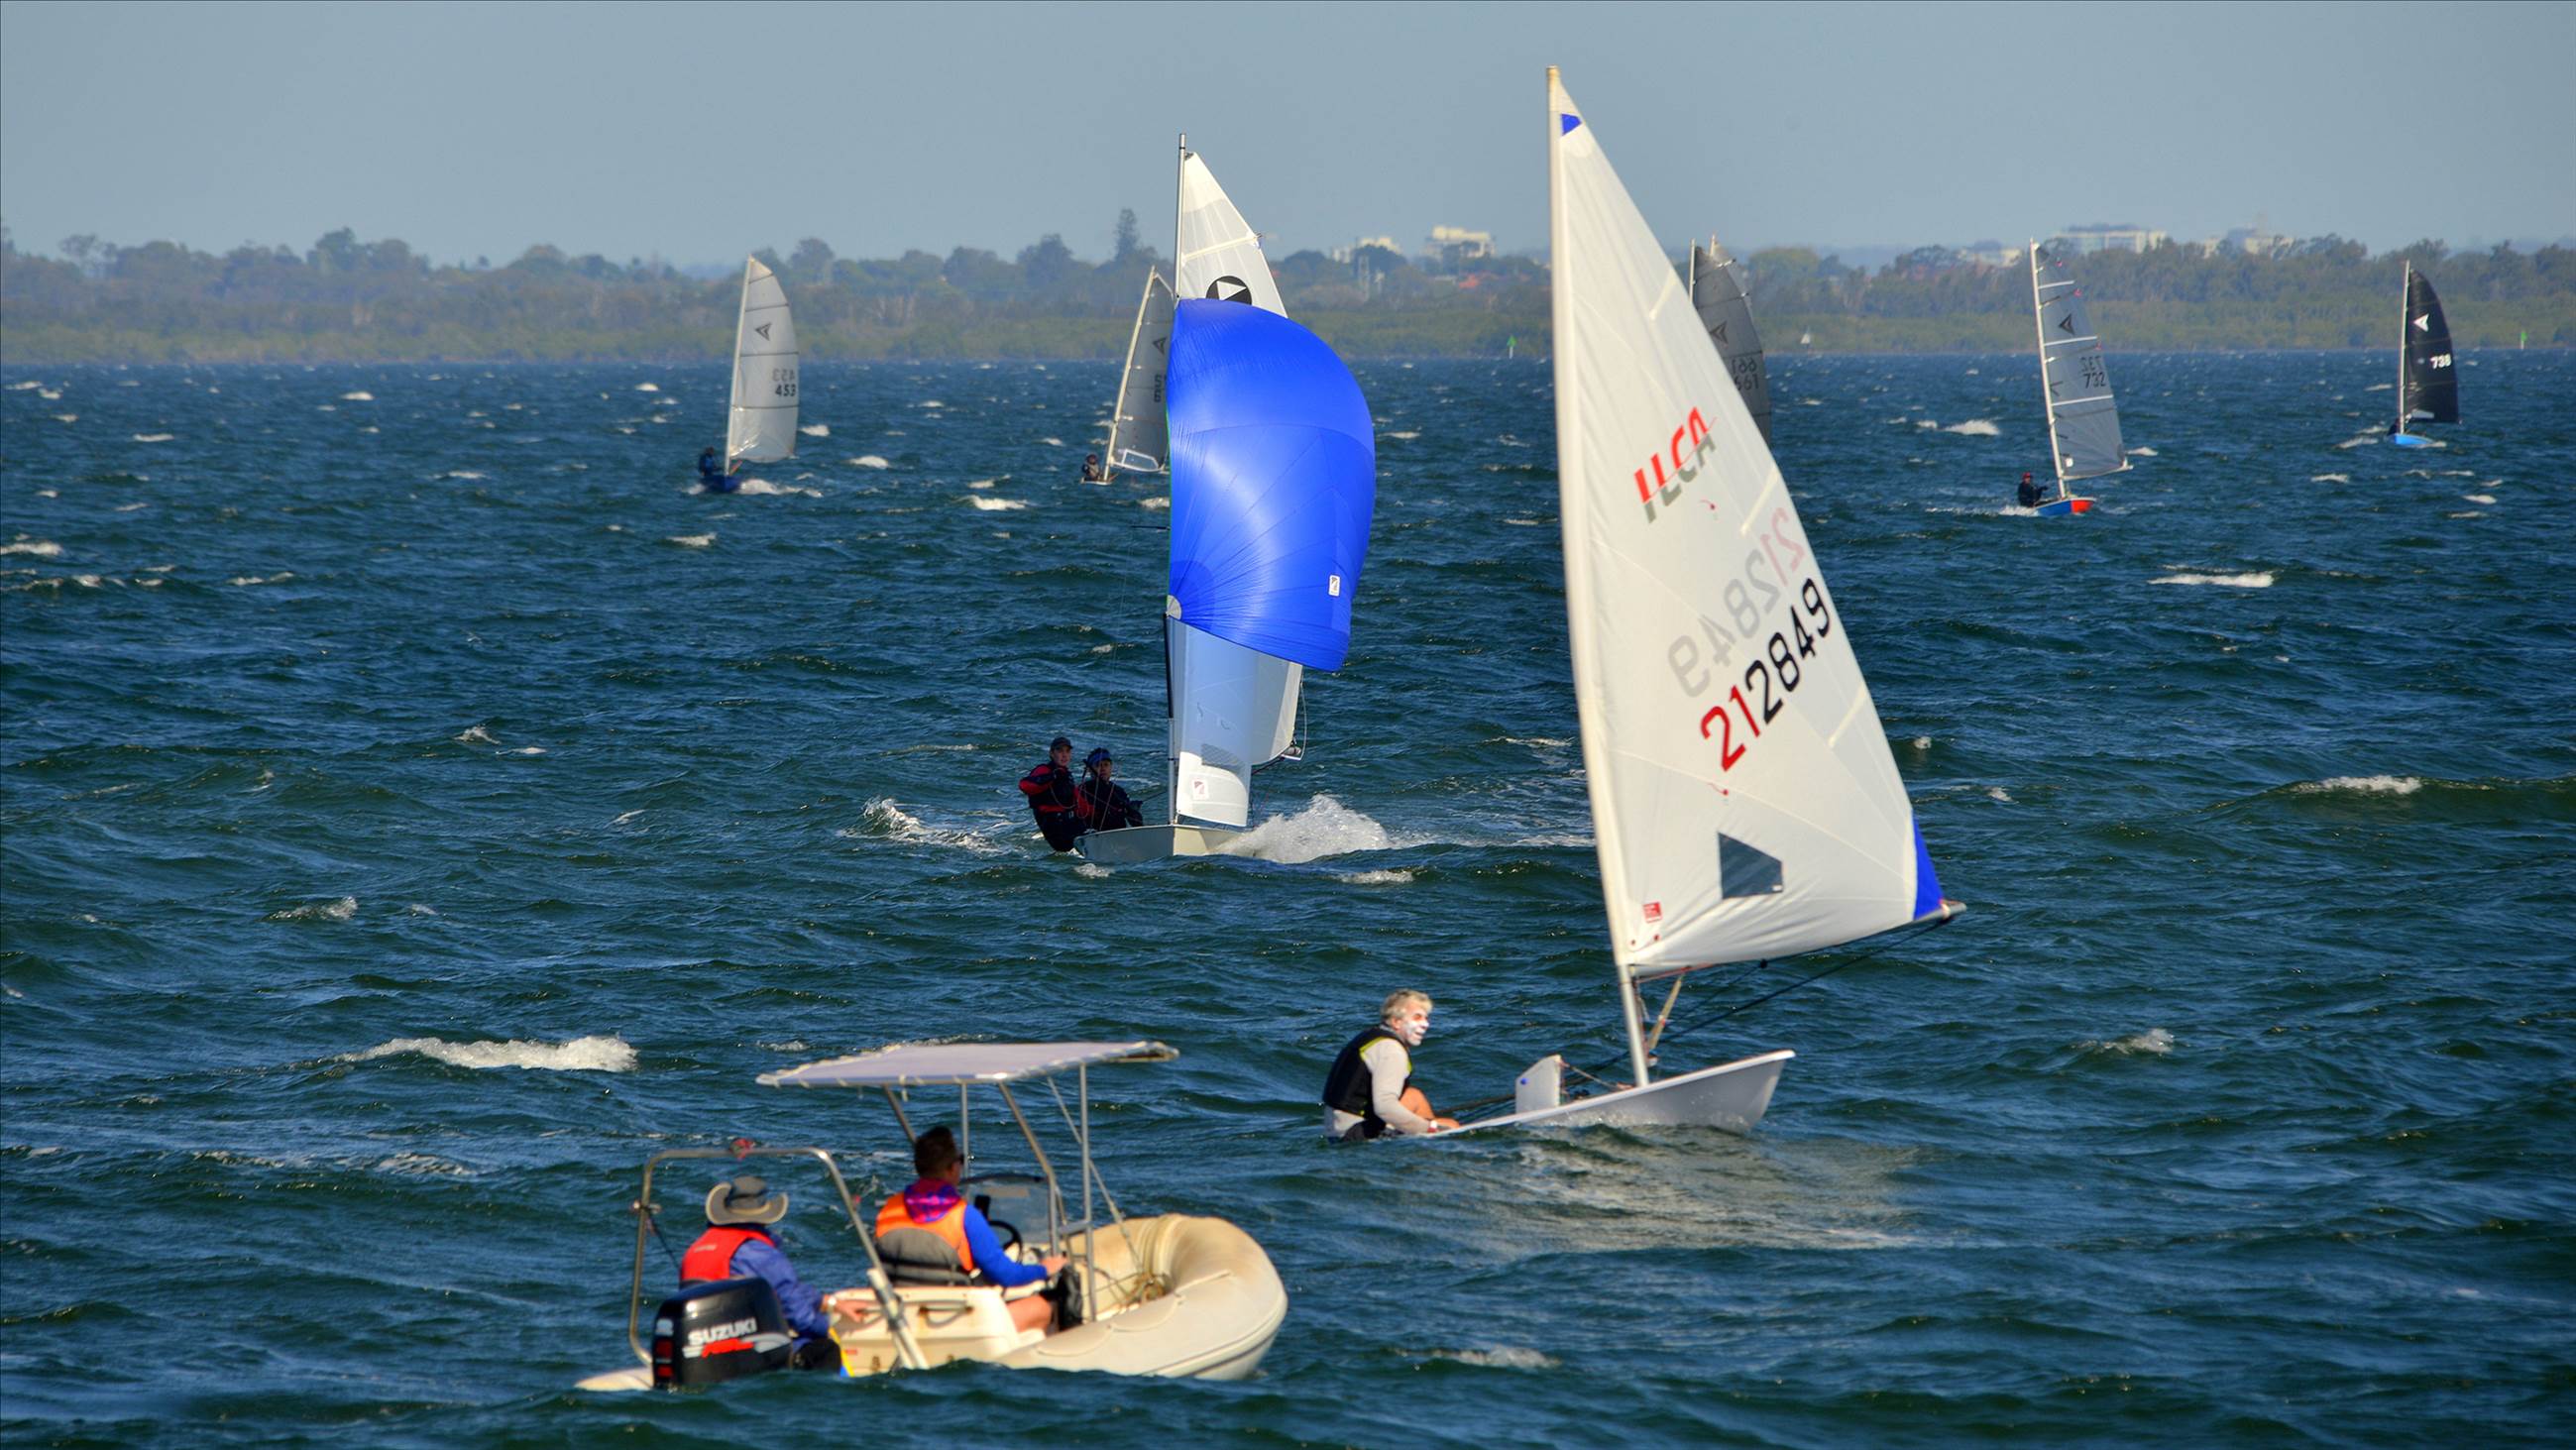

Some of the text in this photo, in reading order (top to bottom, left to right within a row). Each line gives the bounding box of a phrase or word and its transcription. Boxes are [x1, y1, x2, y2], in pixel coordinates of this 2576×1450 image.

[775, 384, 797, 396] 453
[1633, 406, 1717, 524] ILCA
[1700, 578, 1831, 772] 212849
[688, 1317, 758, 1346] SUZUKI
